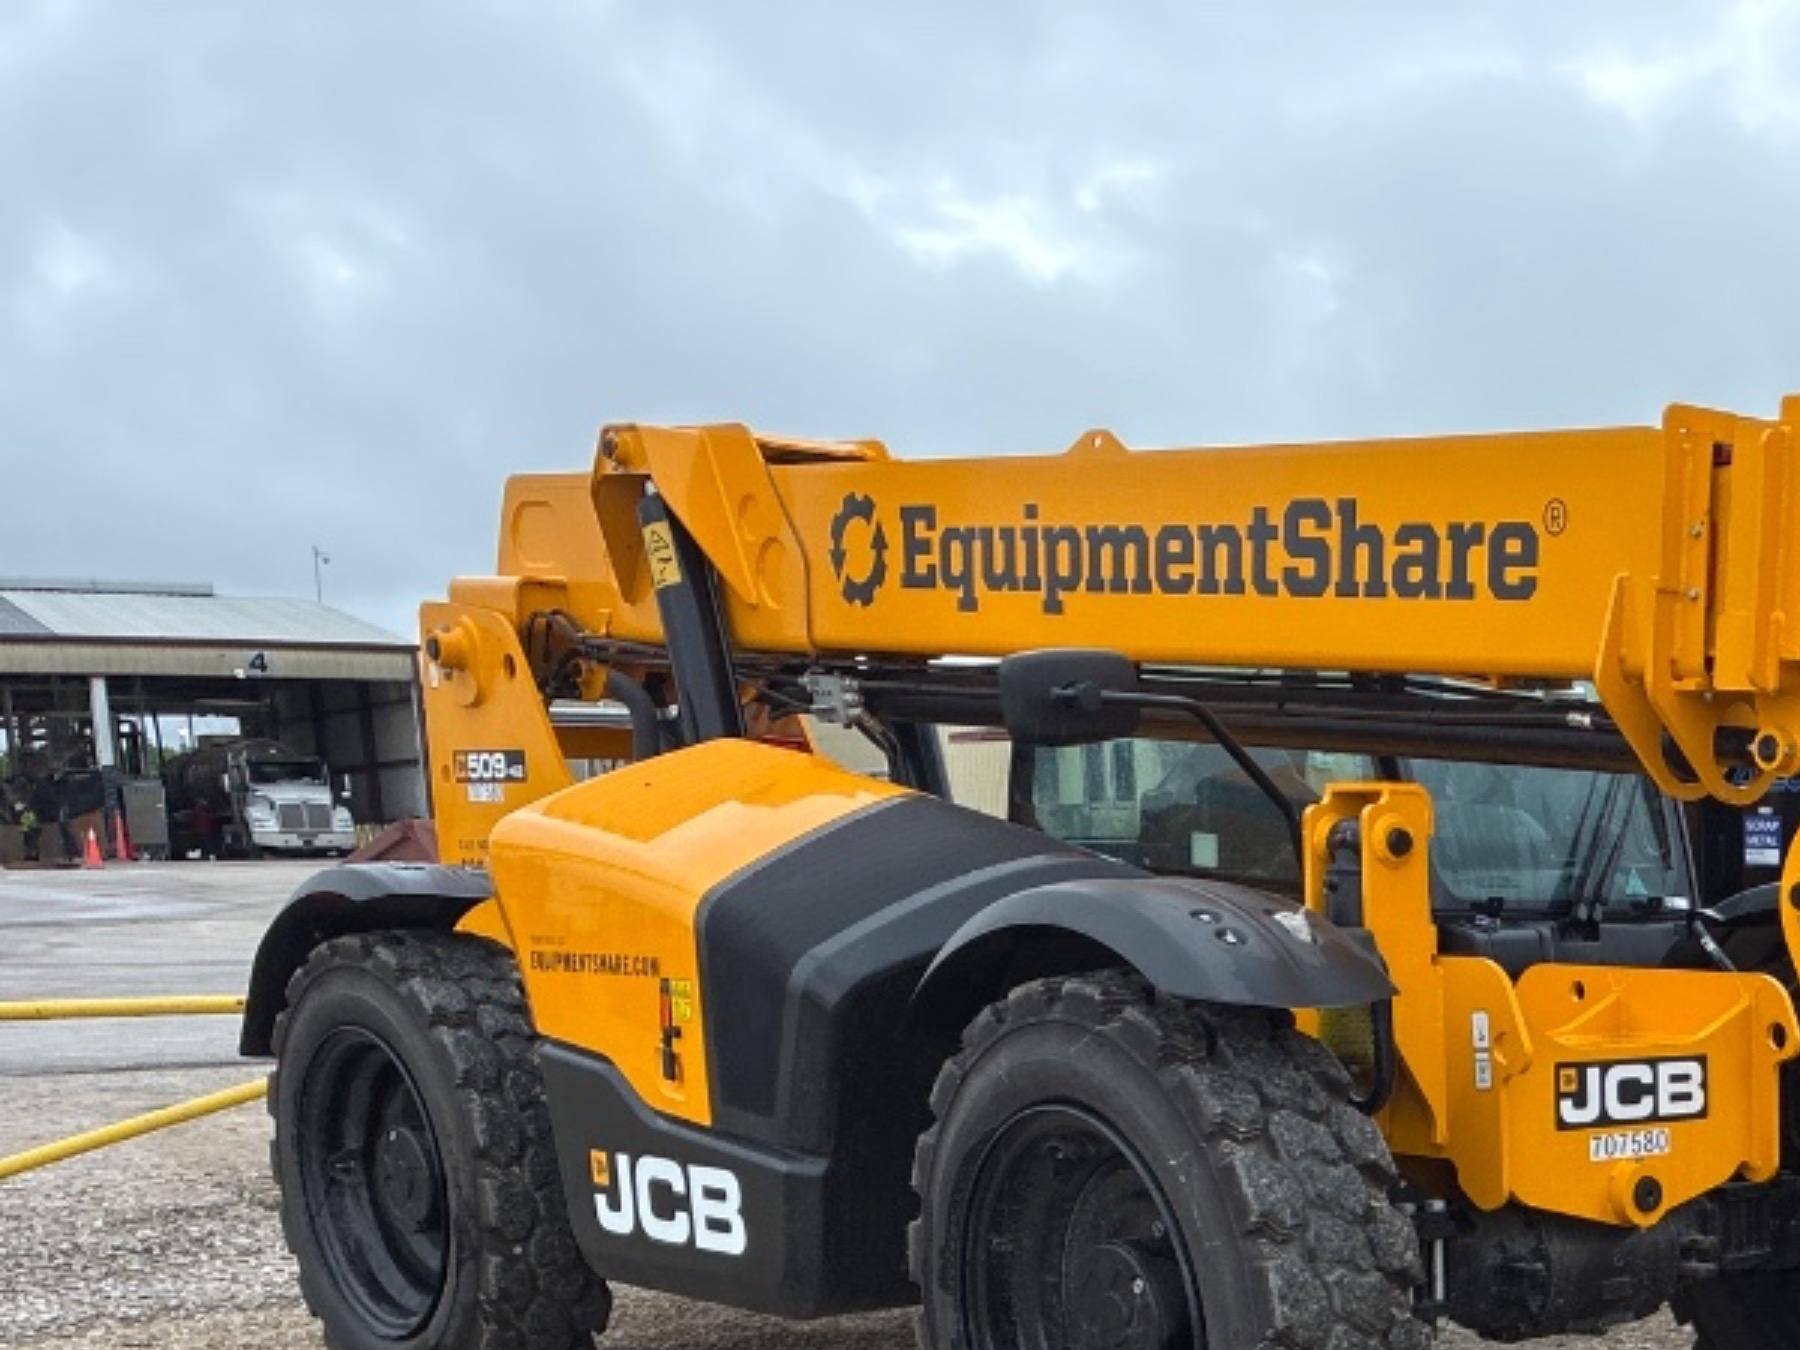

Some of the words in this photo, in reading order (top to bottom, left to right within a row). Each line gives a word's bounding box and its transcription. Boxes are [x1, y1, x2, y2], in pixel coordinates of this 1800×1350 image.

[249, 652, 267, 672] 4
[1745, 820, 1780, 832] SCRAP
[530, 951, 661, 977] EQUIPMENTSHARE.COM
[1559, 1061, 1705, 1123] JCB
[1592, 1130, 1668, 1158] 707580
[593, 1152, 747, 1255] JCB
